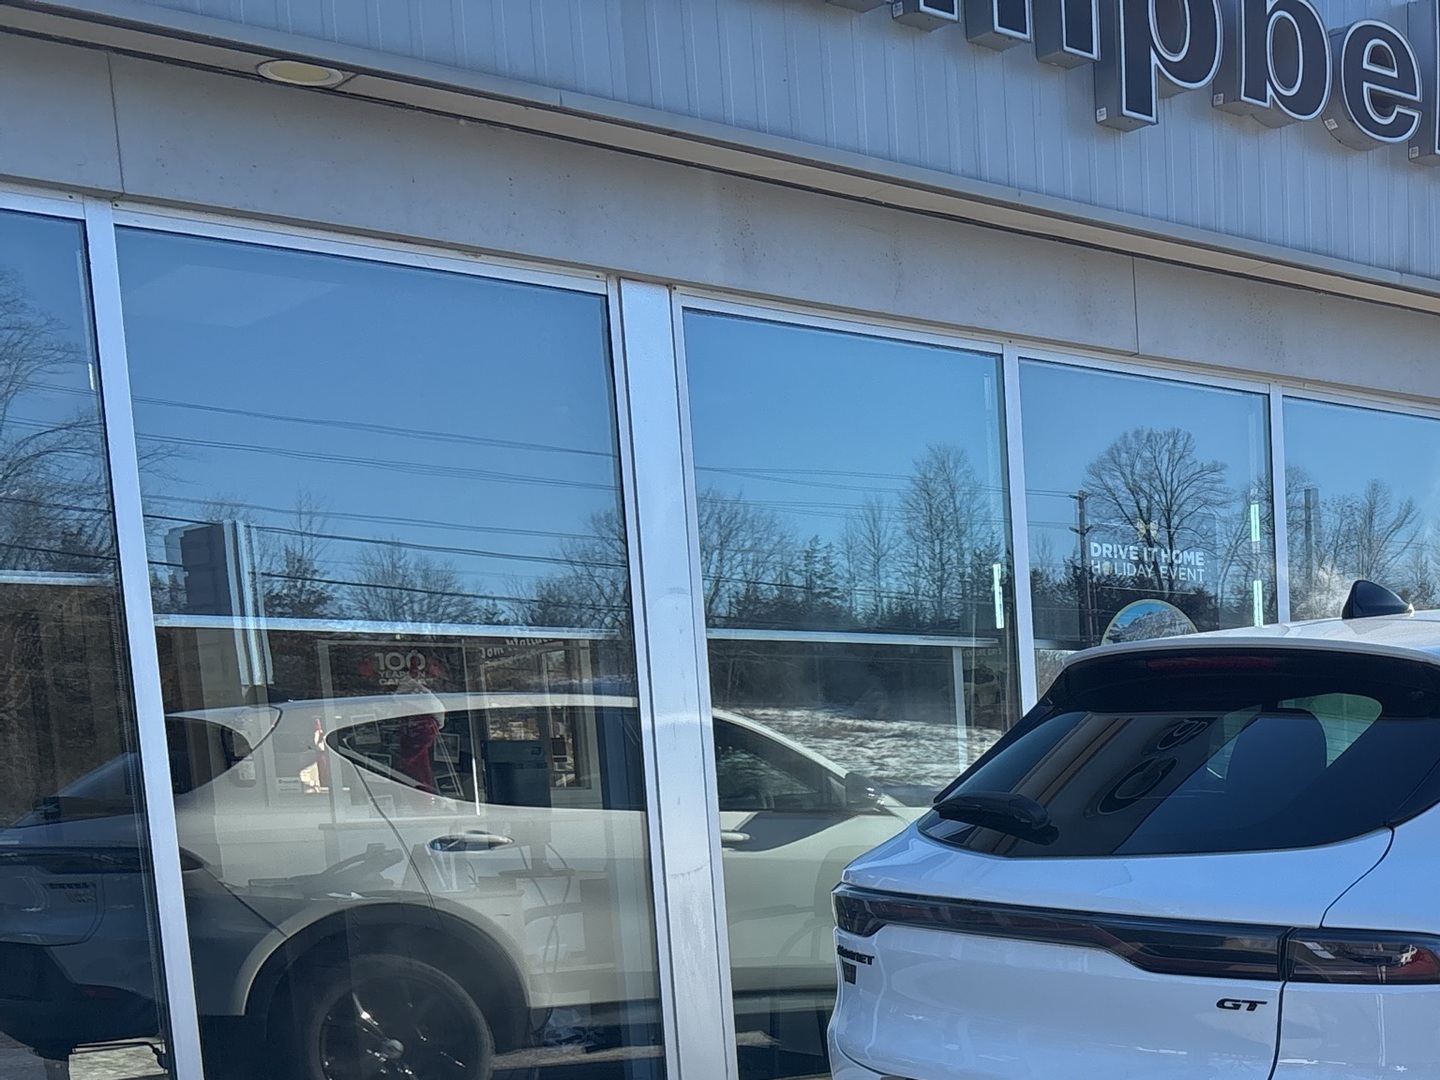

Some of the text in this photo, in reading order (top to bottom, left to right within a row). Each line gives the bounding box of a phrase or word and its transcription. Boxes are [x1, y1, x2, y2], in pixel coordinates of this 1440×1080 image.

[1090, 542, 1204, 566] DRIVE IT HOME
[1091, 560, 1205, 582] HOLIDAY EVENT
[374, 650, 426, 671] 100
[1216, 998, 1268, 1011] GT
